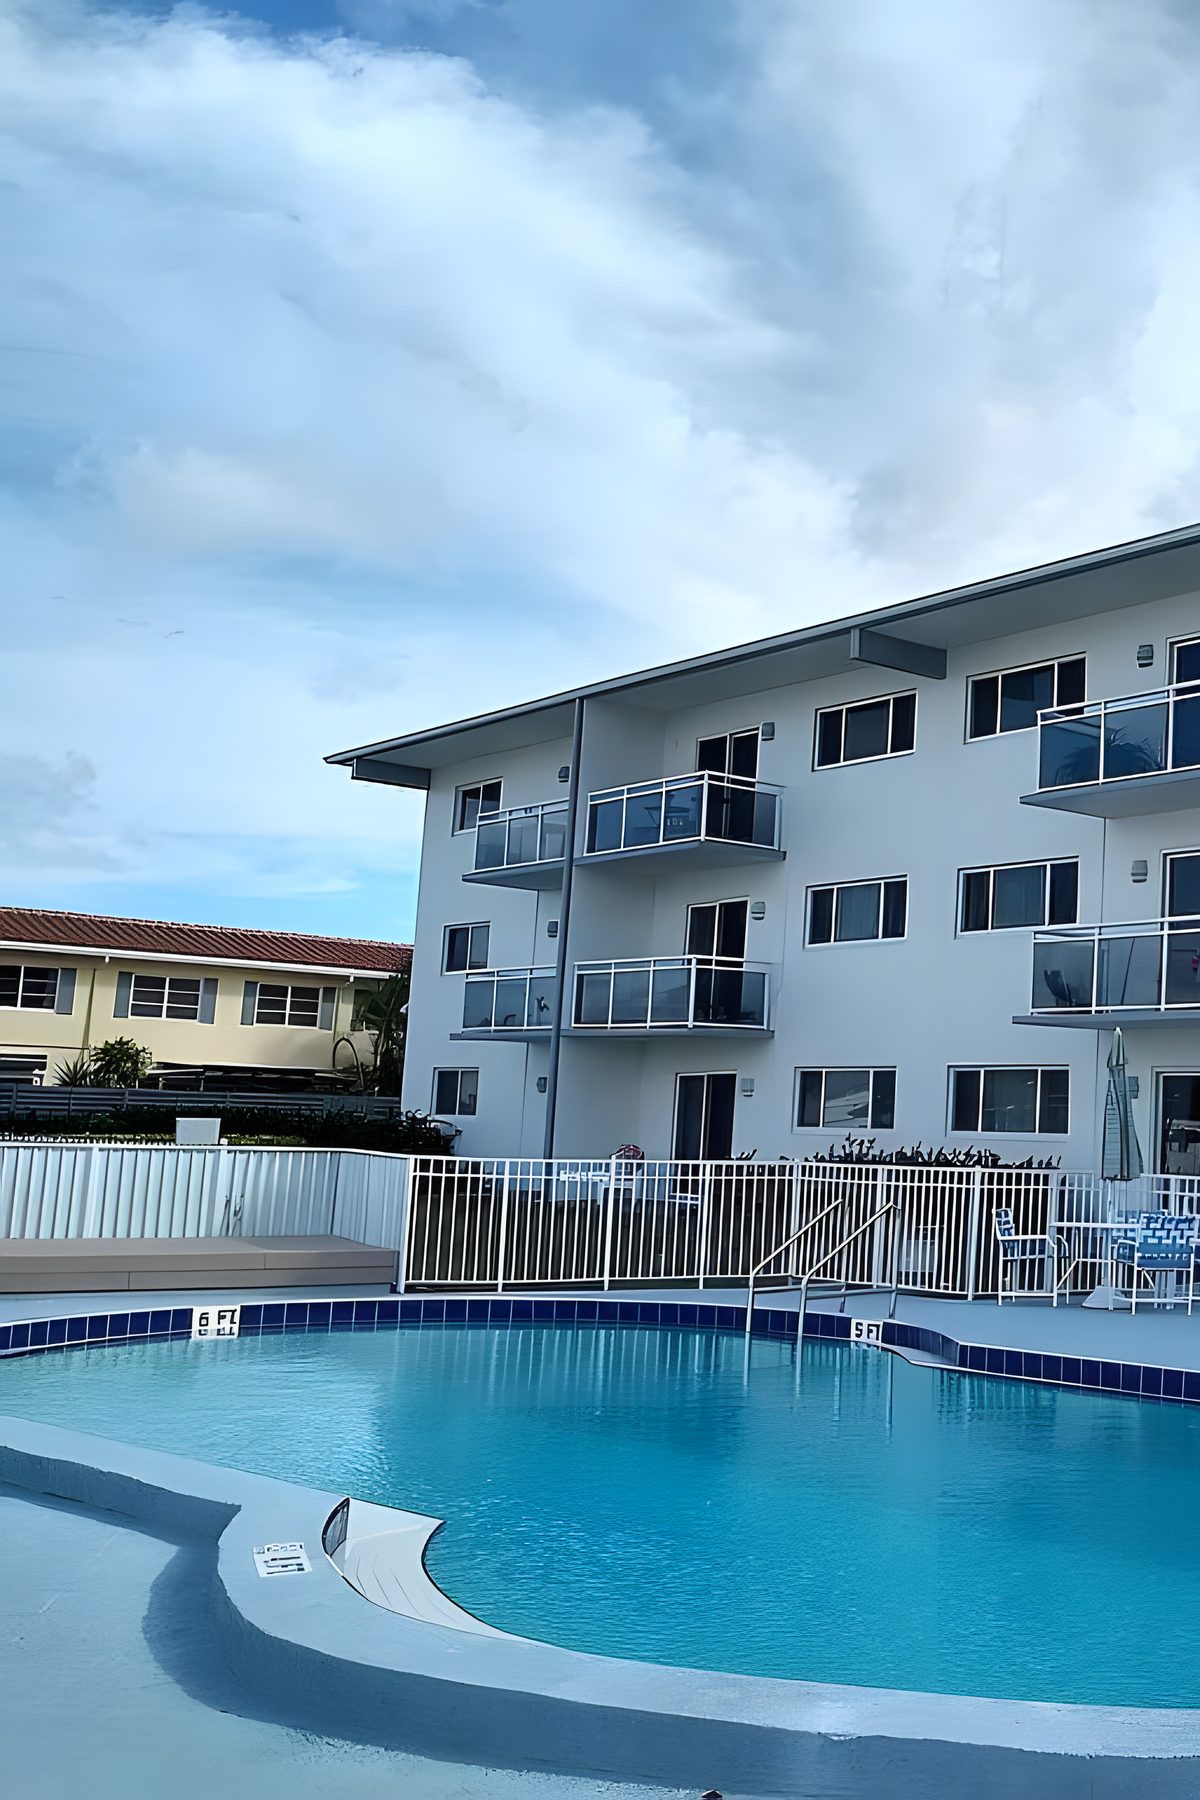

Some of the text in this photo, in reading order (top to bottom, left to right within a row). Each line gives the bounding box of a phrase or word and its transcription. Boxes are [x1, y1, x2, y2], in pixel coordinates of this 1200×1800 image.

[199, 1309, 237, 1327] 6 FT
[855, 1322, 880, 1341] 5 FT
